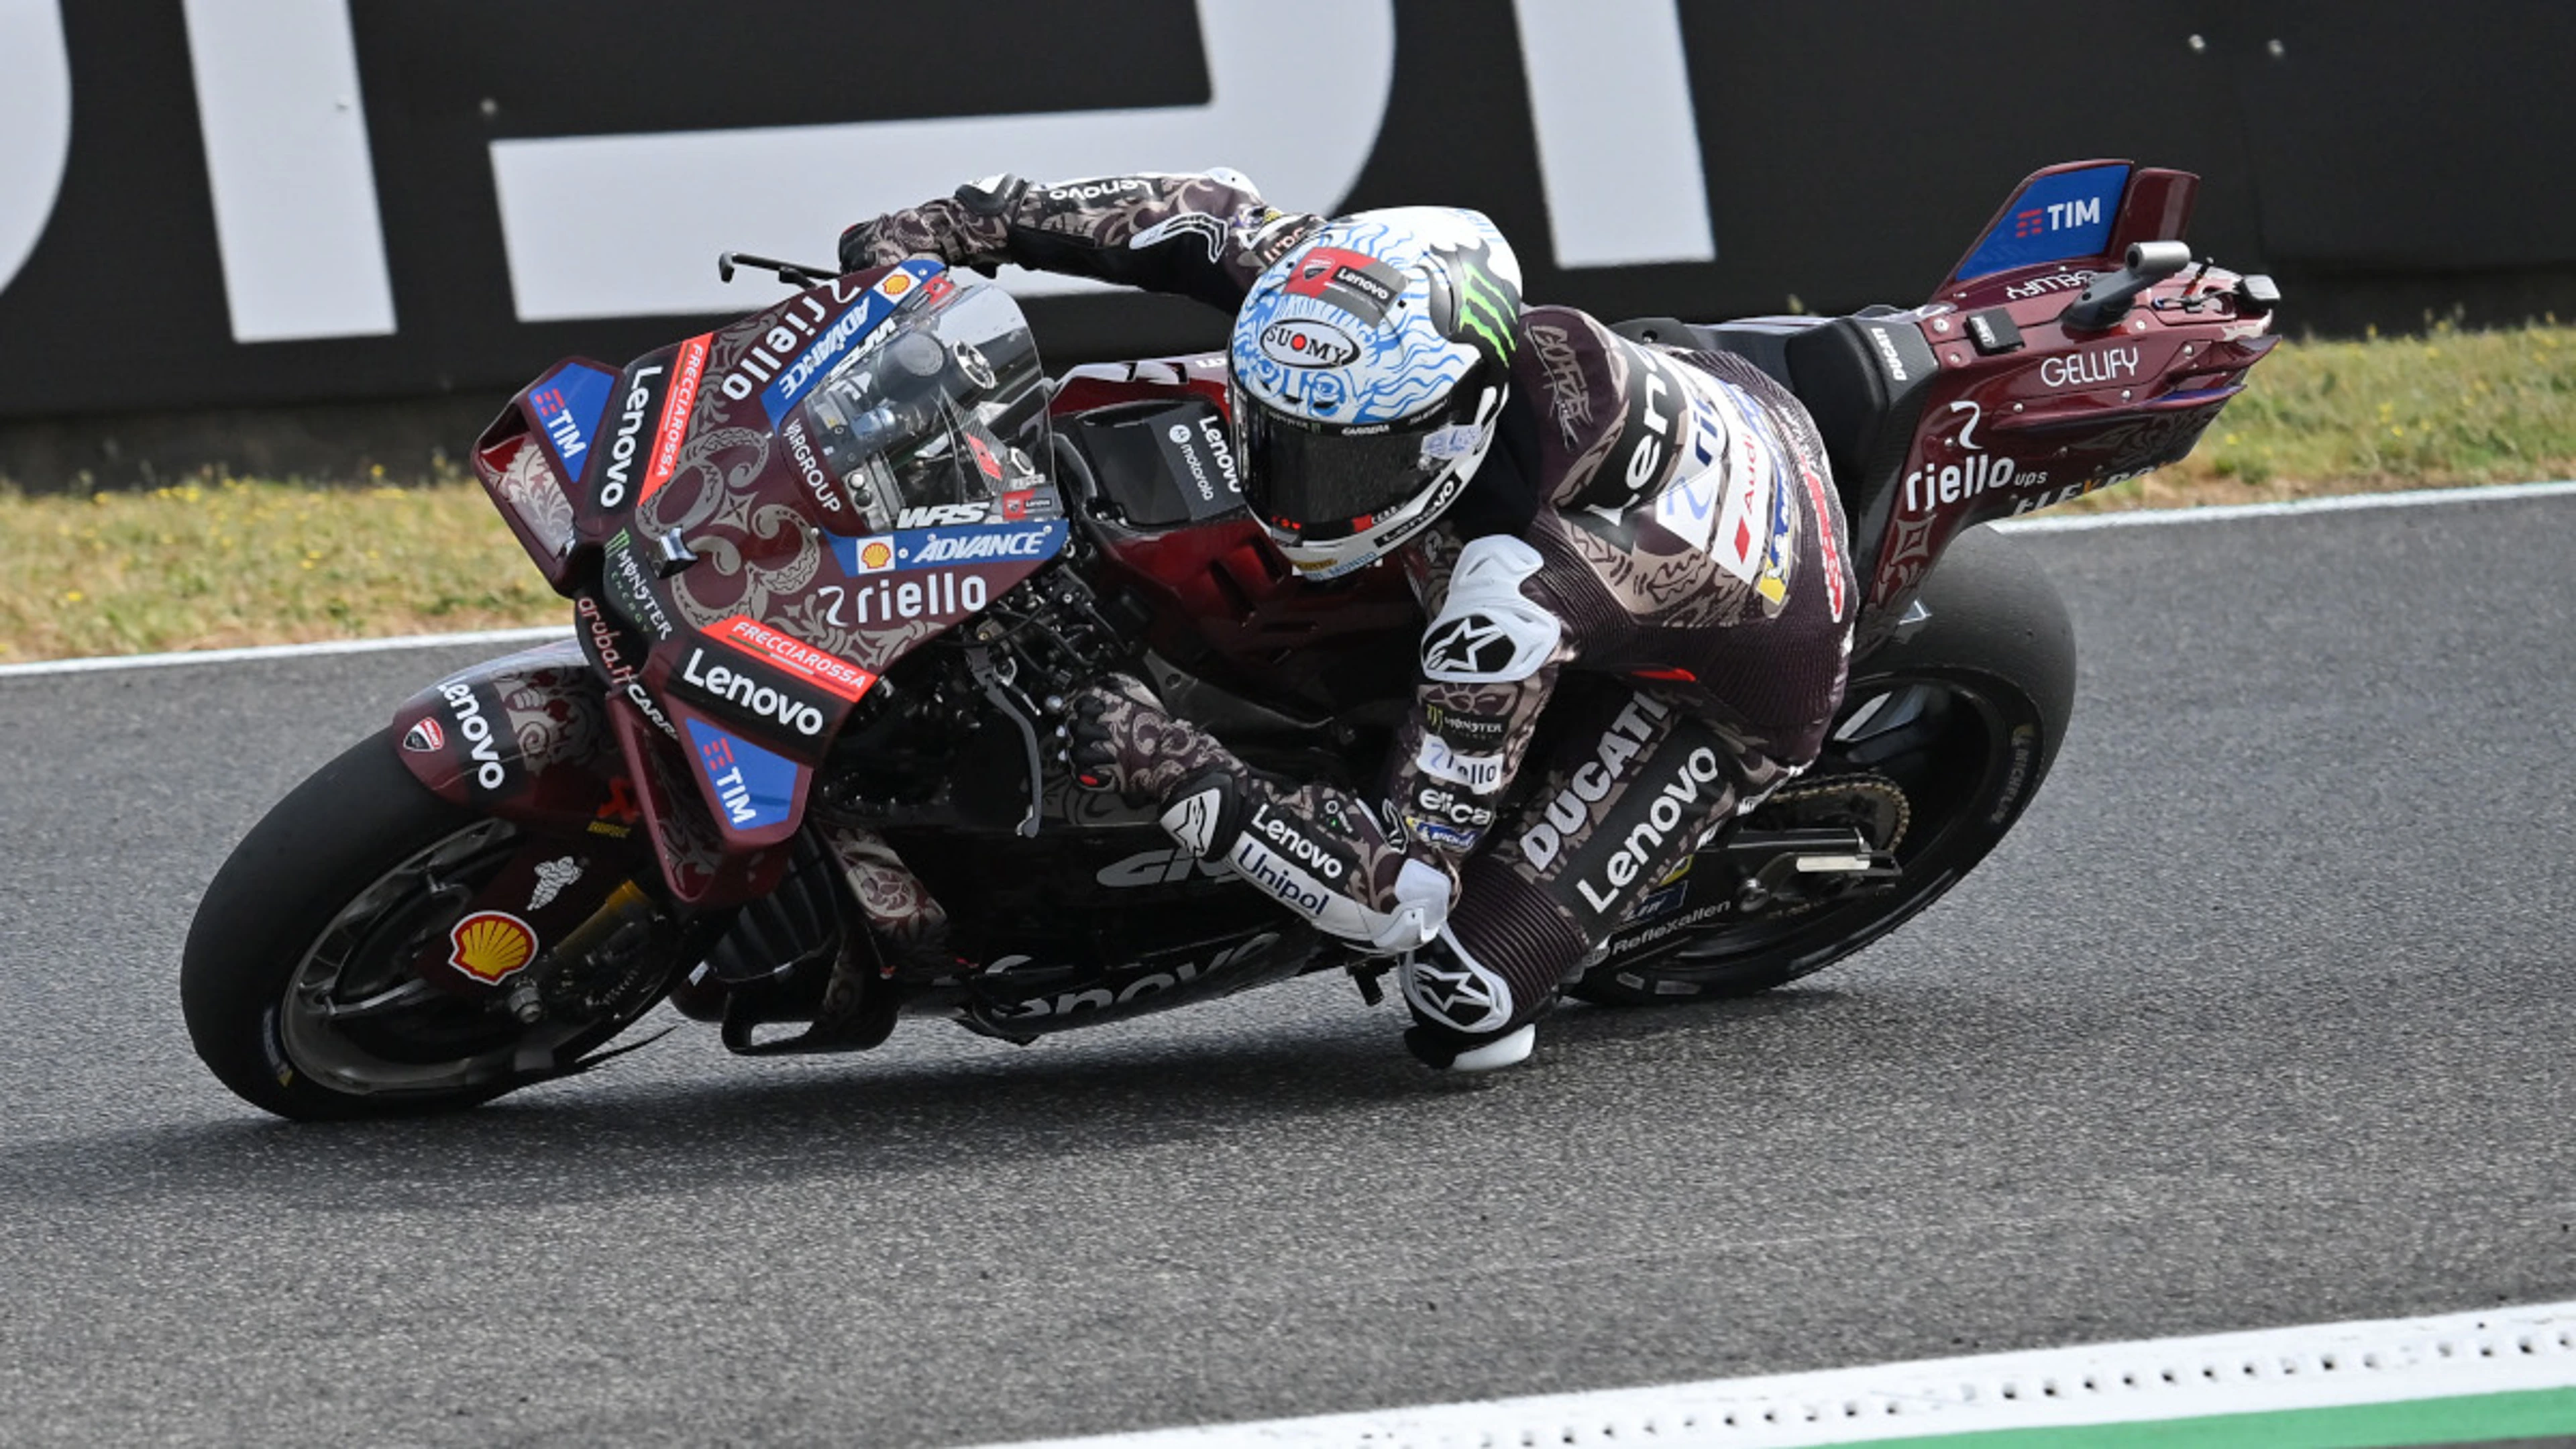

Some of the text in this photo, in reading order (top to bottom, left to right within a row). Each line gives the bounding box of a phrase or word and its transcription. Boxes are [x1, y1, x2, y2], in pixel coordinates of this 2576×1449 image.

[1049, 178, 1152, 200] Lenovo
[2047, 197, 2101, 231] TIM
[1337, 268, 1389, 300] Lenovo
[722, 296, 826, 400] riello
[778, 297, 870, 400] ADVANCE
[1266, 327, 1350, 366] SUOMY
[2040, 346, 2139, 388] GELLIFY
[546, 409, 586, 459] TIM
[600, 365, 662, 508] Lenovo
[657, 343, 703, 478] FRECCIAROSSA
[786, 419, 841, 514] VARGROUP
[1180, 443, 1214, 501] motorola
[1906, 455, 2049, 513] riello ups
[897, 502, 989, 529] WRS
[912, 531, 1044, 564] ADVANCE
[618, 549, 672, 641] MONSTER
[857, 573, 987, 623] riello
[578, 598, 637, 684] aruba.it
[732, 621, 866, 690] FRECCIAROSSA
[683, 648, 823, 736] Lenovo
[436, 676, 505, 790] Lenovo
[716, 767, 757, 824] TIM
[1419, 788, 1491, 826] elica
[1519, 691, 1669, 872] DUCATI
[1250, 804, 1342, 880] Lenovo
[1576, 747, 1719, 914] Lenovo
[1238, 841, 1330, 917] Unipol
[1611, 899, 1731, 956] Reflexallen
